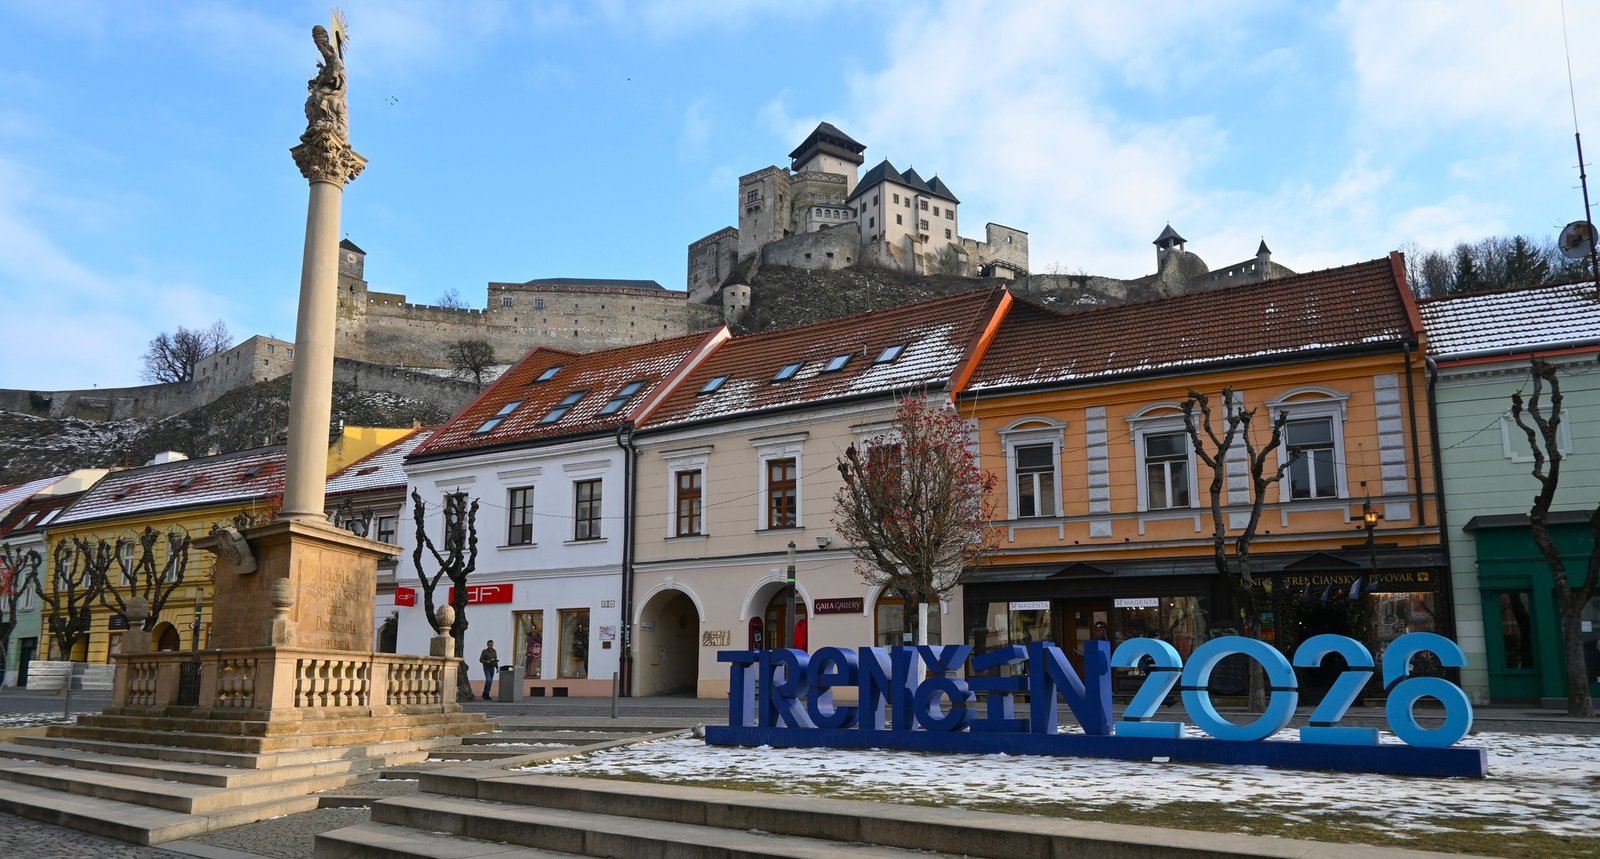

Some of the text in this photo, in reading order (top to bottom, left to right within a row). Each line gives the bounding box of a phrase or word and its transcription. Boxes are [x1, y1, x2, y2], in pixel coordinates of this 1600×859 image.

[835, 601, 861, 611] GALLERY
[1124, 599, 1158, 607] MAGENTA
[1111, 632, 1473, 748] 2026
